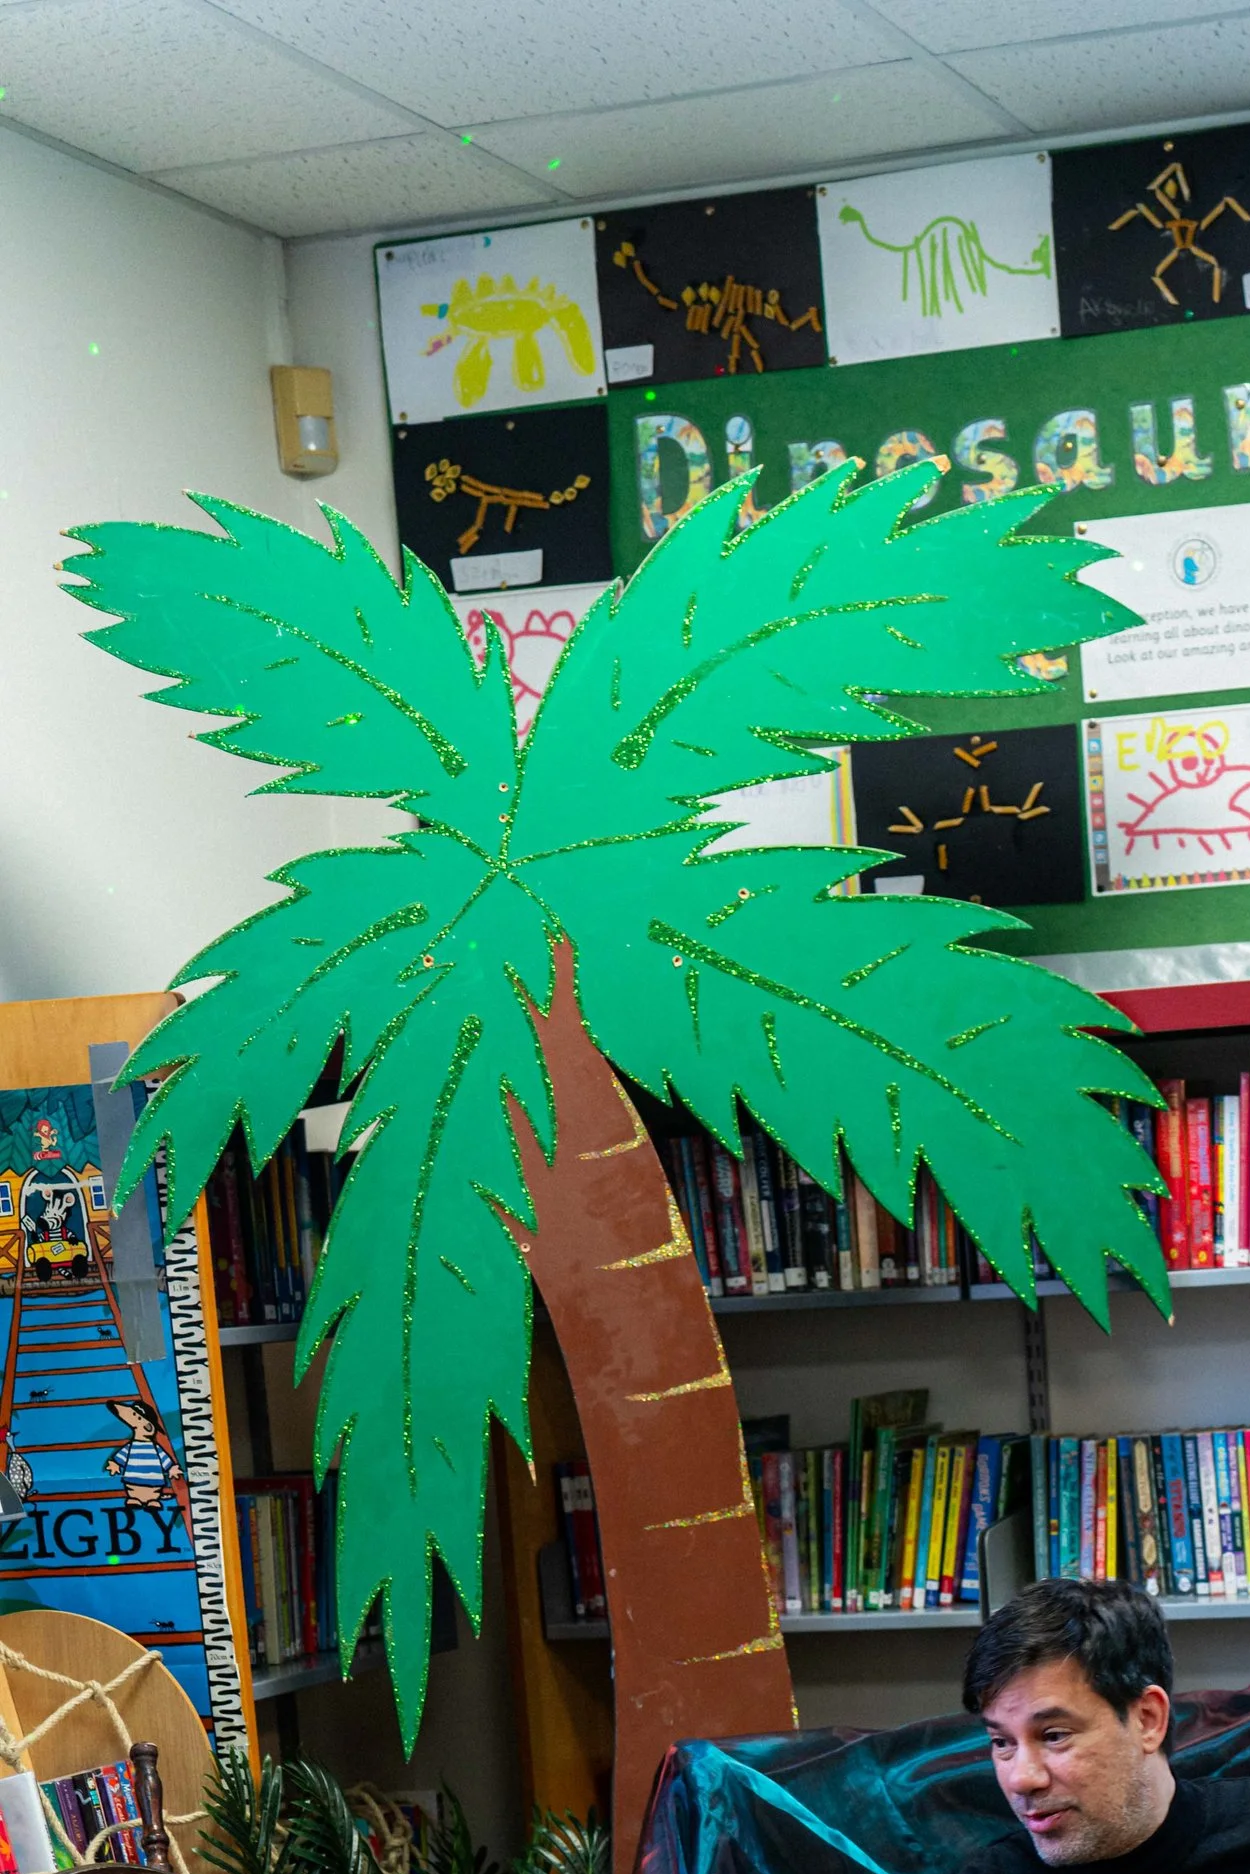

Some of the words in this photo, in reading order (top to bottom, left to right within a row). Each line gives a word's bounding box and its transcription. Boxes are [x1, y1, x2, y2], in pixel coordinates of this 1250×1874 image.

[1144, 607, 1193, 622] ception,
[1197, 606, 1214, 617] we
[1219, 602, 1250, 615] have
[1163, 626, 1180, 640] all
[1183, 623, 1220, 638] about
[1107, 651, 1136, 665] Look
[1140, 650, 1154, 662] at
[1157, 648, 1178, 660] our
[1182, 643, 1235, 658] amazing
[715, 1154, 734, 1198] WARP
[757, 1159, 770, 1197] COLFER
[977, 1454, 992, 1504] GORDON'S
[1184, 1440, 1197, 1481] INVENTING
[0, 1506, 186, 1560] ZIGBY
